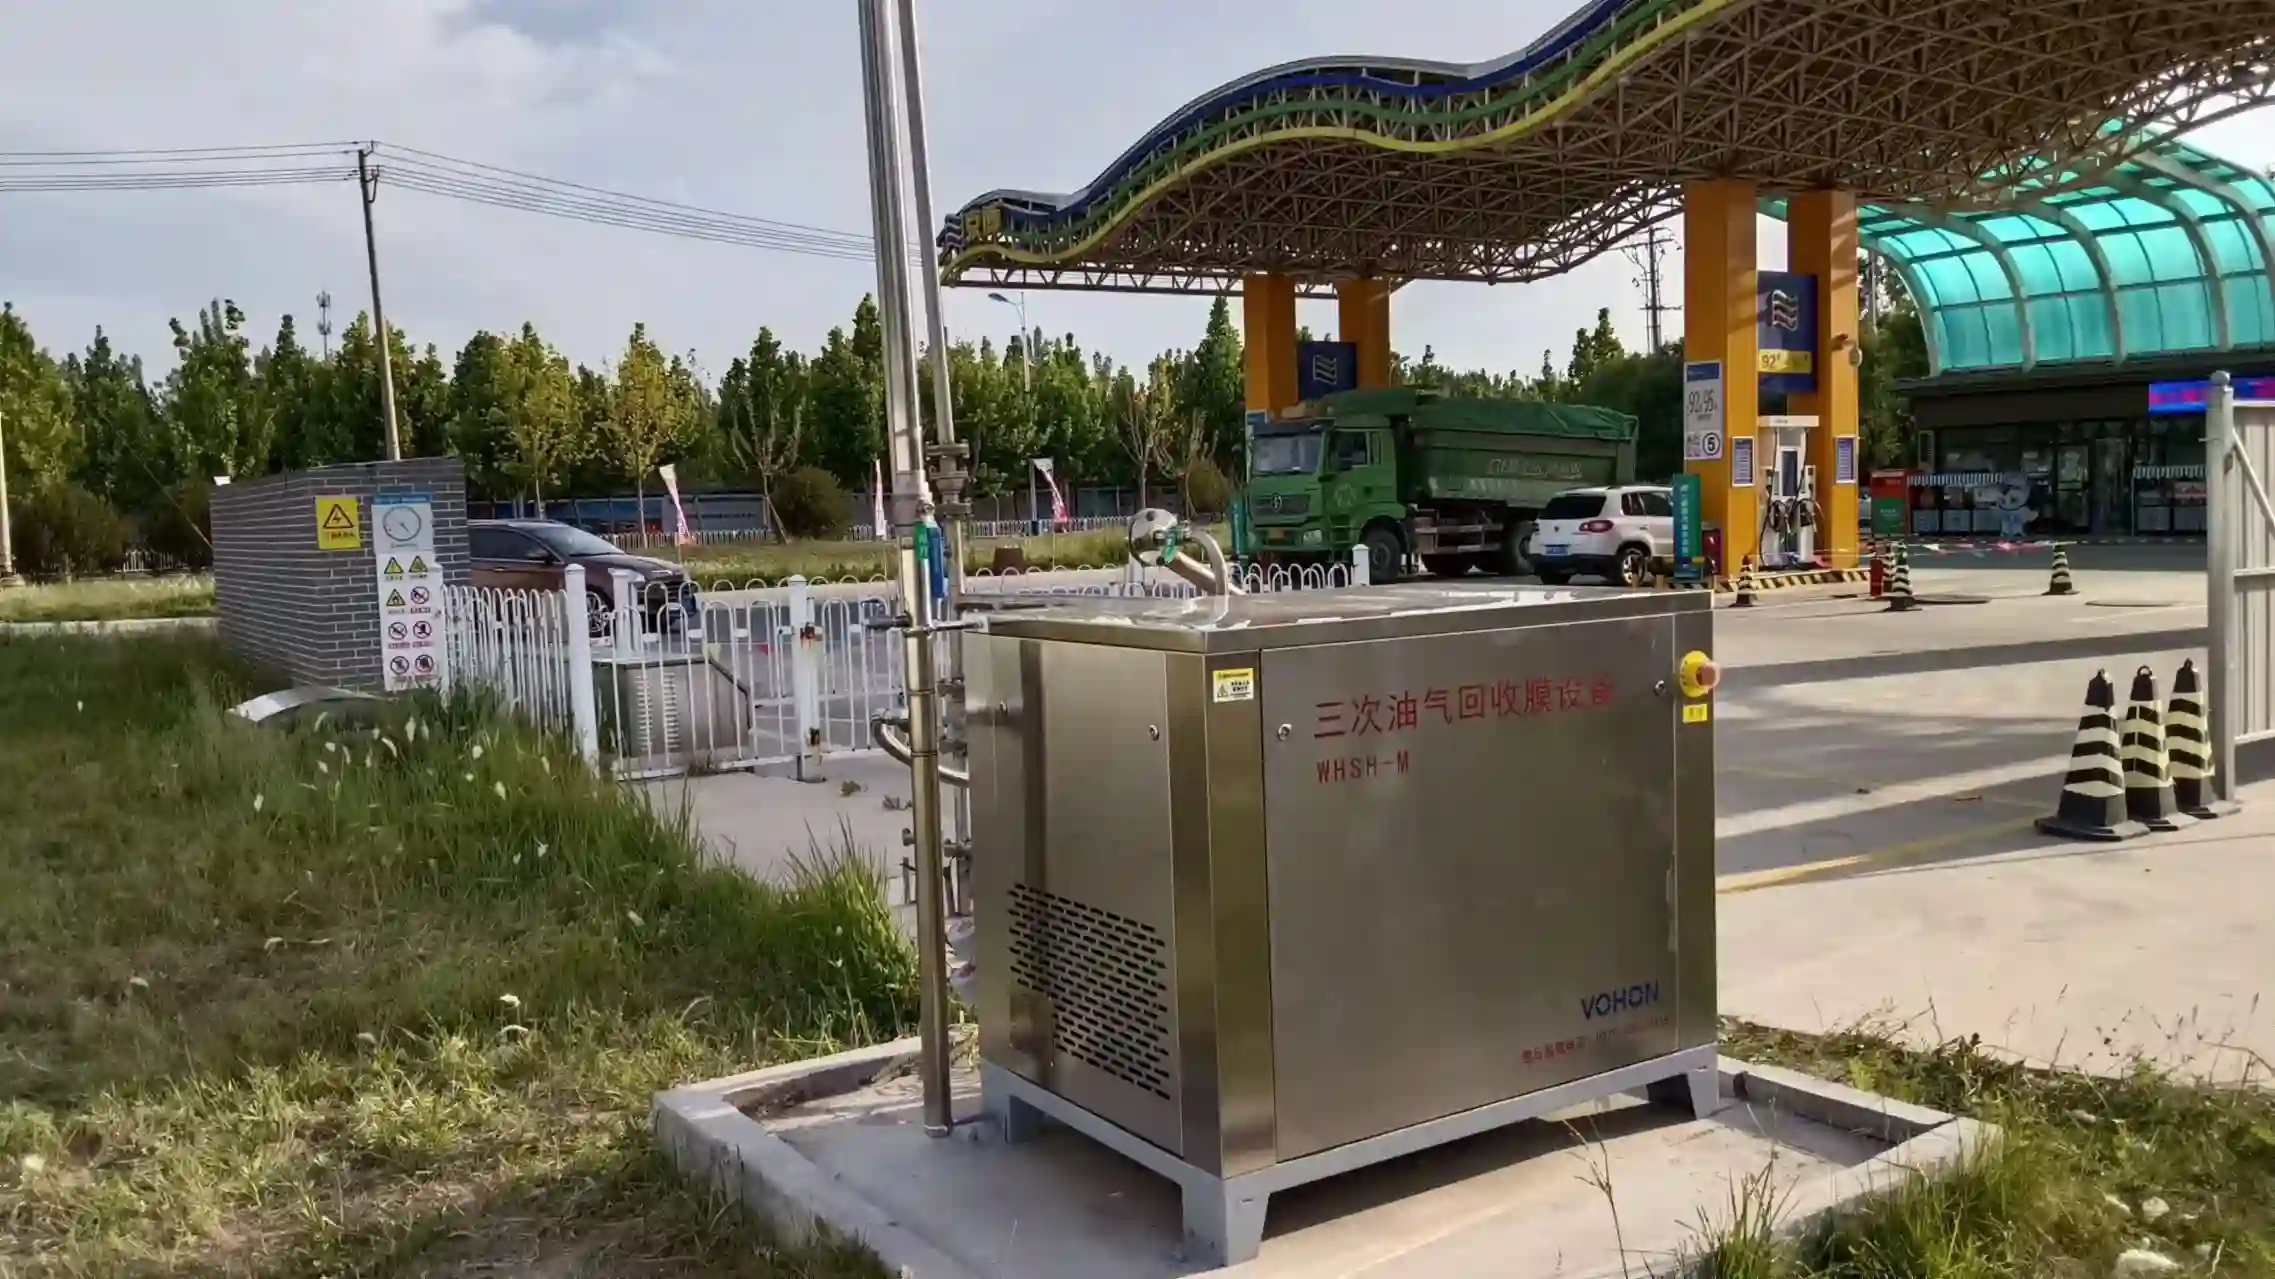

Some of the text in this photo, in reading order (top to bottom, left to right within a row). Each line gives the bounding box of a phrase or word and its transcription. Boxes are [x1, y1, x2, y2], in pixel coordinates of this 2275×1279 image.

[1313, 671, 1616, 739] 三次油气回收膜设备
[1316, 751, 1410, 784] WHSH-M
[1580, 980, 1659, 1021] VOHON
